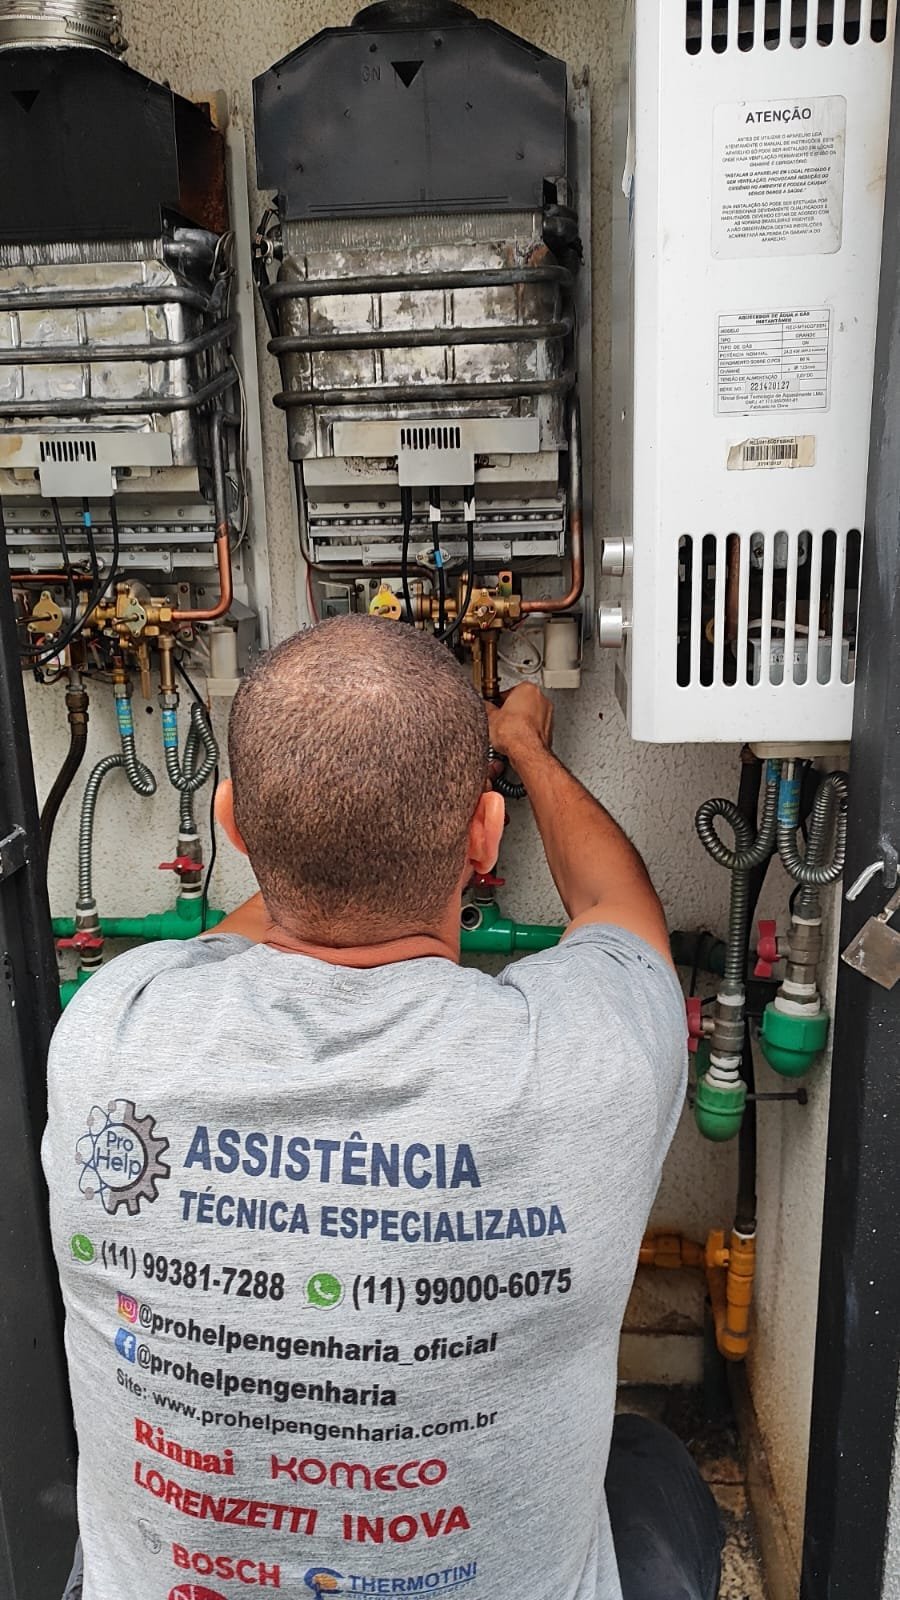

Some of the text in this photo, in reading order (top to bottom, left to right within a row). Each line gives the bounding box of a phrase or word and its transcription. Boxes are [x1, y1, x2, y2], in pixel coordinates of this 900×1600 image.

[745, 106, 812, 124] ATENÇÃO
[96, 1147, 142, 1180] Help
[106, 1130, 134, 1151] Pro
[183, 1126, 481, 1189] ASSISTÊNCIA
[179, 1186, 567, 1243] TÉCNICA ESPECIALIZADA
[101, 1240, 285, 1301] (11) 99381-7288
[352, 1267, 572, 1312] (11) 99000-6075
[139, 1304, 498, 1366] @prohelpengenharia_oficial
[137, 1344, 397, 1406] @prohelpengenharia
[116, 1368, 498, 1442] Site: www.prohelpengenharia.com.br
[134, 1417, 236, 1475] Rinnai
[134, 1461, 318, 1535] LORENZETTI
[343, 1505, 471, 1544] INOVA
[172, 1542, 281, 1588] BOSCH
[348, 1562, 477, 1592] THERMOTINI
